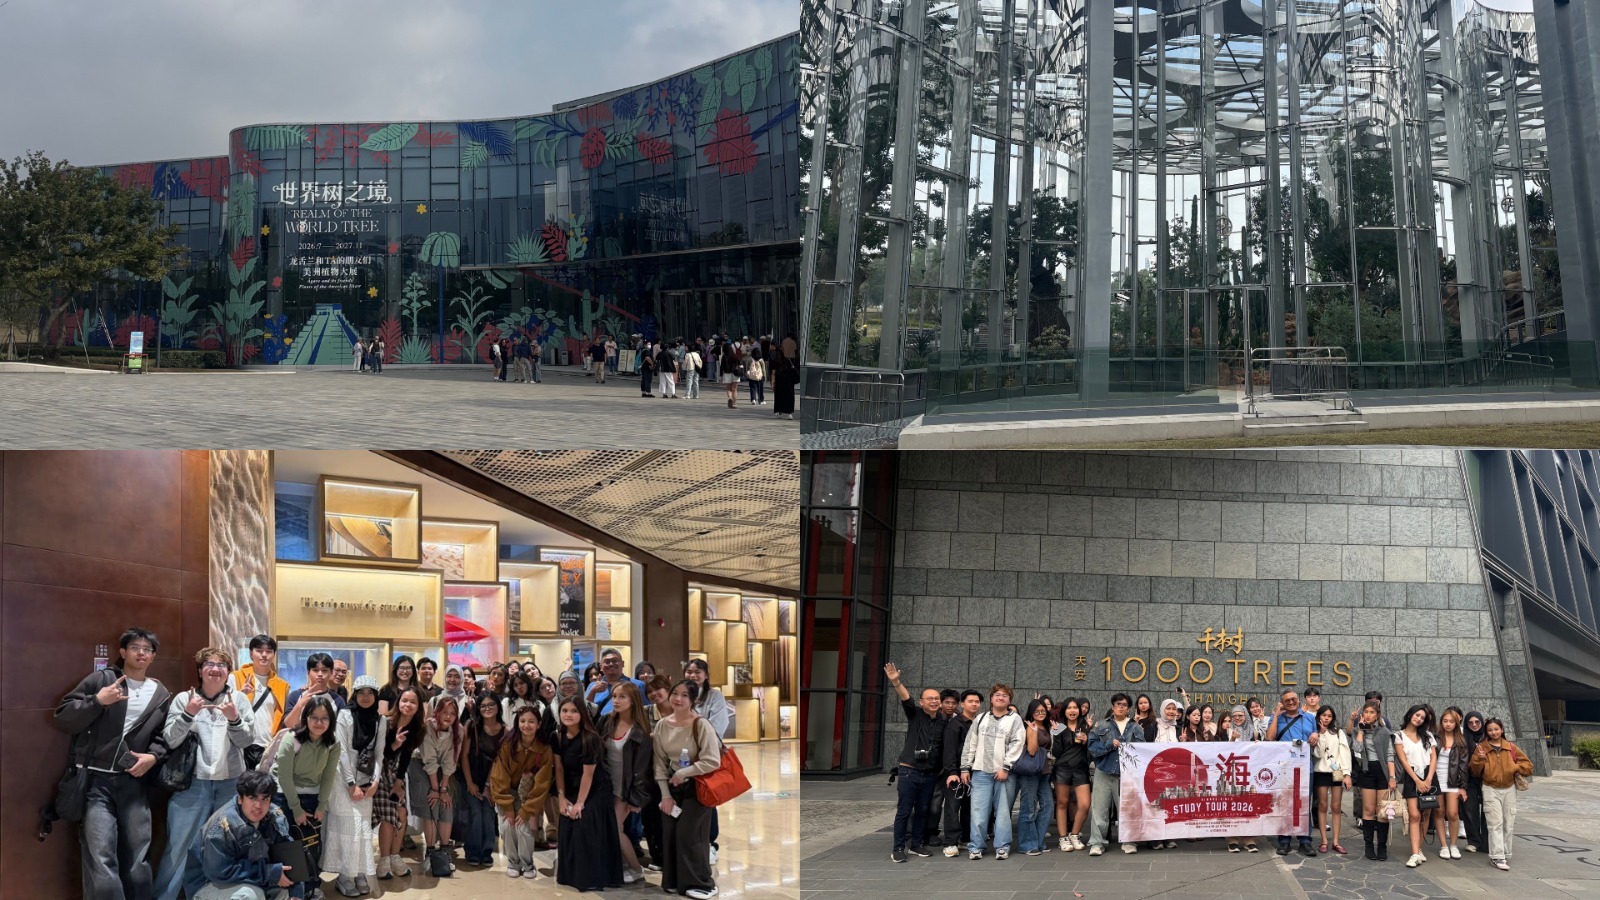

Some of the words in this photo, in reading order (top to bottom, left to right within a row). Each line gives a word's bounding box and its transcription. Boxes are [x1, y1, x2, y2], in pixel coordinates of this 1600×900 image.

[272, 179, 392, 209] 世界树之境
[293, 209, 330, 219] REALM
[333, 209, 348, 218] OF
[350, 208, 372, 218] THE
[285, 219, 338, 233] WORLD
[341, 220, 379, 232] TREE
[289, 255, 372, 266] 龙舌兰和TA的朋友们
[302, 267, 358, 277] 美洲植物大展
[379, 601, 414, 612] studio
[1197, 627, 1243, 654] 千树
[1074, 655, 1086, 681] 天安
[1101, 656, 1214, 683] 1000
[1226, 659, 1352, 687] TREES
[1186, 693, 1268, 705] SHANGHI
[1173, 802, 1201, 815] STUDY
[1205, 801, 1228, 811] TOUR
[1231, 802, 1254, 812] 2026
